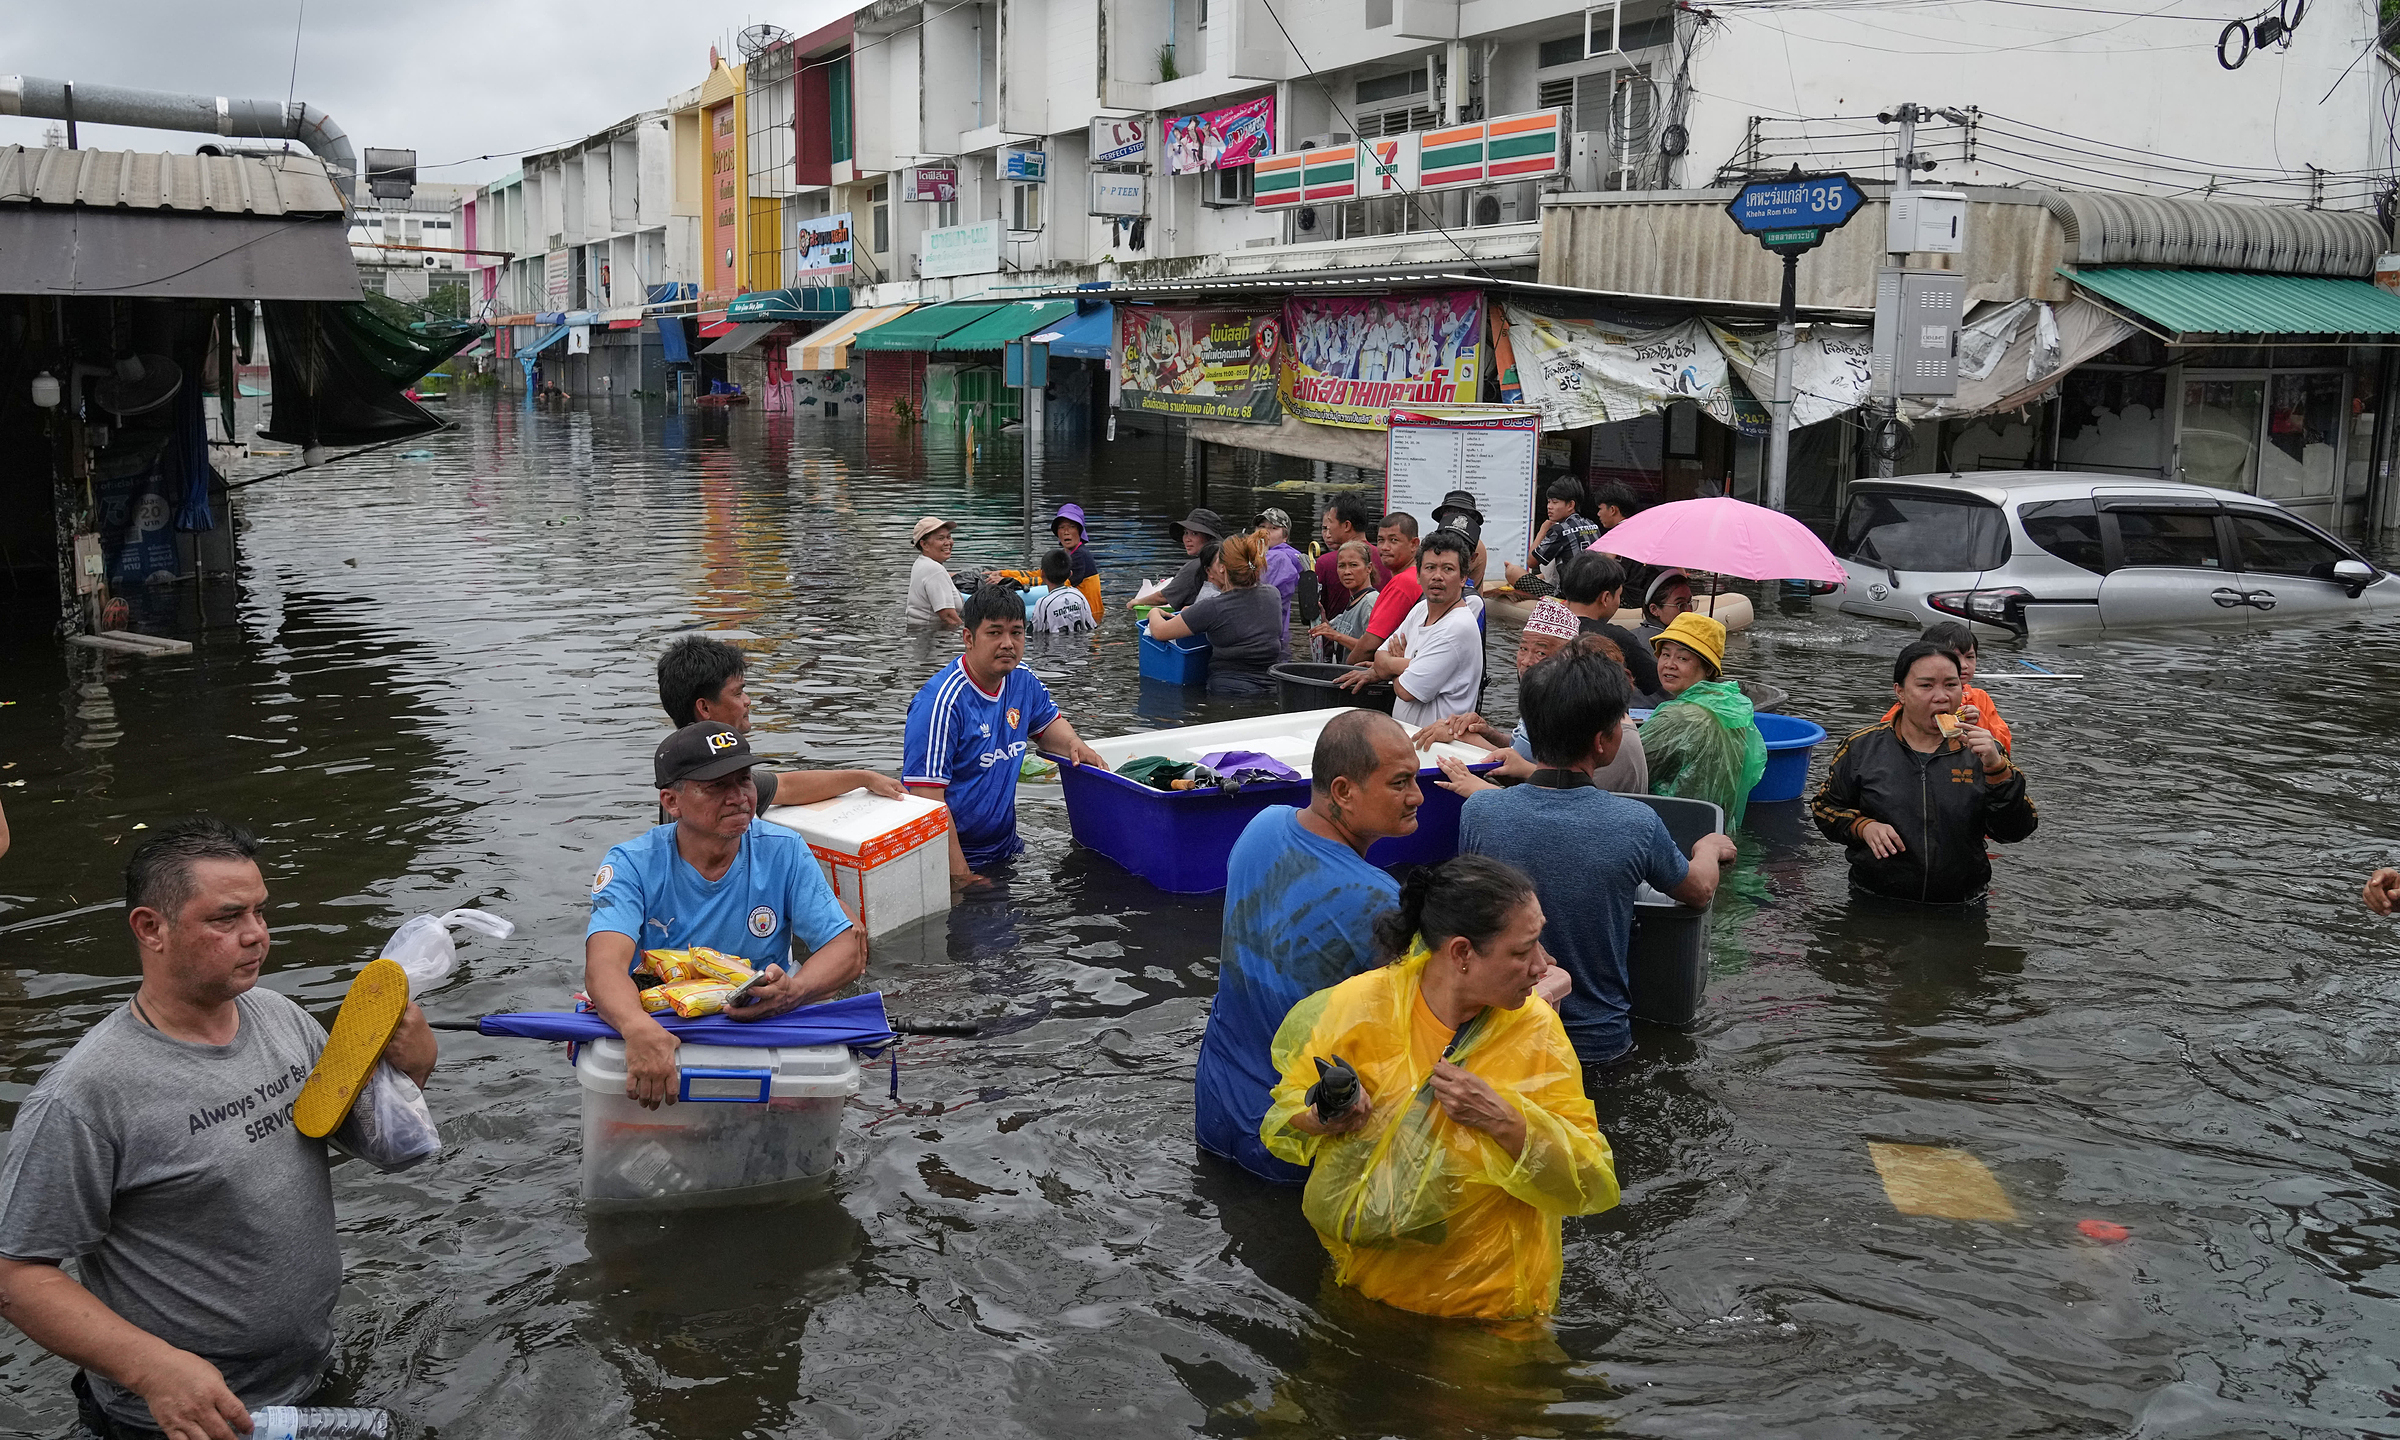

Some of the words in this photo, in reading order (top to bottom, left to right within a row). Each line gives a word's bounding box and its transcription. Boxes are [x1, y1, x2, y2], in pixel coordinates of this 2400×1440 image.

[1100, 147, 1127, 161] PERFECT
[1128, 143, 1144, 153] STEP
[918, 170, 949, 180] ไดฟีลีน
[1377, 141, 1397, 190] 7
[1100, 186, 1117, 195] PP
[1117, 187, 1139, 197] TEEN
[1746, 183, 1809, 207] เคหะร่มเกล้า
[1811, 186, 1843, 212] 35
[1746, 210, 1765, 218] Kheha
[1782, 207, 1797, 215] Klao
[1768, 230, 1814, 241] เขตลาดกระบัง
[1210, 316, 1252, 347] โบนัสสุกี้
[1817, 337, 1873, 356] โสมอินซั
[1251, 363, 1270, 382] 219
[1170, 400, 1202, 414] รามคำแหง
[1203, 402, 1215, 415] เปิด
[1217, 404, 1225, 416] 10
[1241, 406, 1252, 418] 68
[141, 505, 161, 520] 20
[144, 519, 160, 527] บาท
[706, 732, 738, 755] pcs
[979, 741, 1027, 768] SARP
[189, 1095, 256, 1136] Always
[254, 1073, 290, 1103] Your
[245, 1099, 297, 1144] SERVIC
